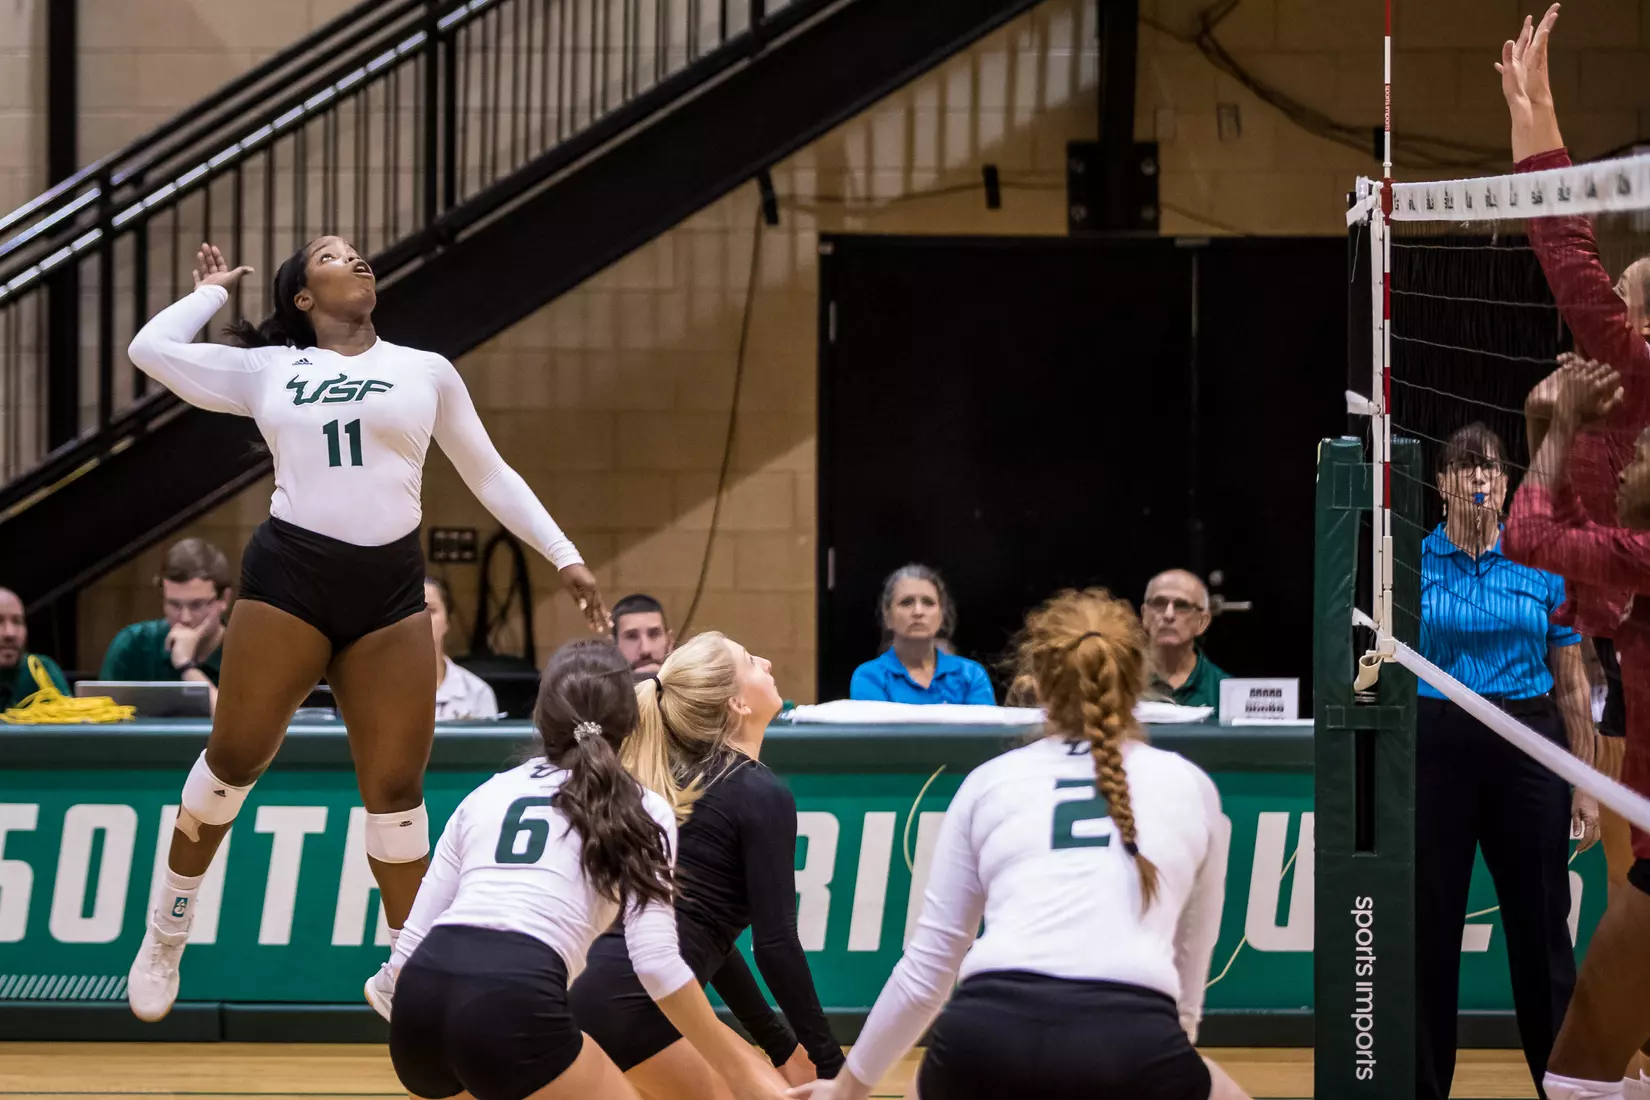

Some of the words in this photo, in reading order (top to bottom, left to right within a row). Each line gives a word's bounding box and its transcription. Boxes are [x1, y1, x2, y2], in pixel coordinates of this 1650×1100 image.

[286, 373, 394, 406] USF
[322, 418, 363, 467] 11
[494, 796, 553, 865] 6
[1051, 778, 1112, 850] 2
[1350, 895, 1377, 977] sports
[1350, 981, 1377, 1080] imports
